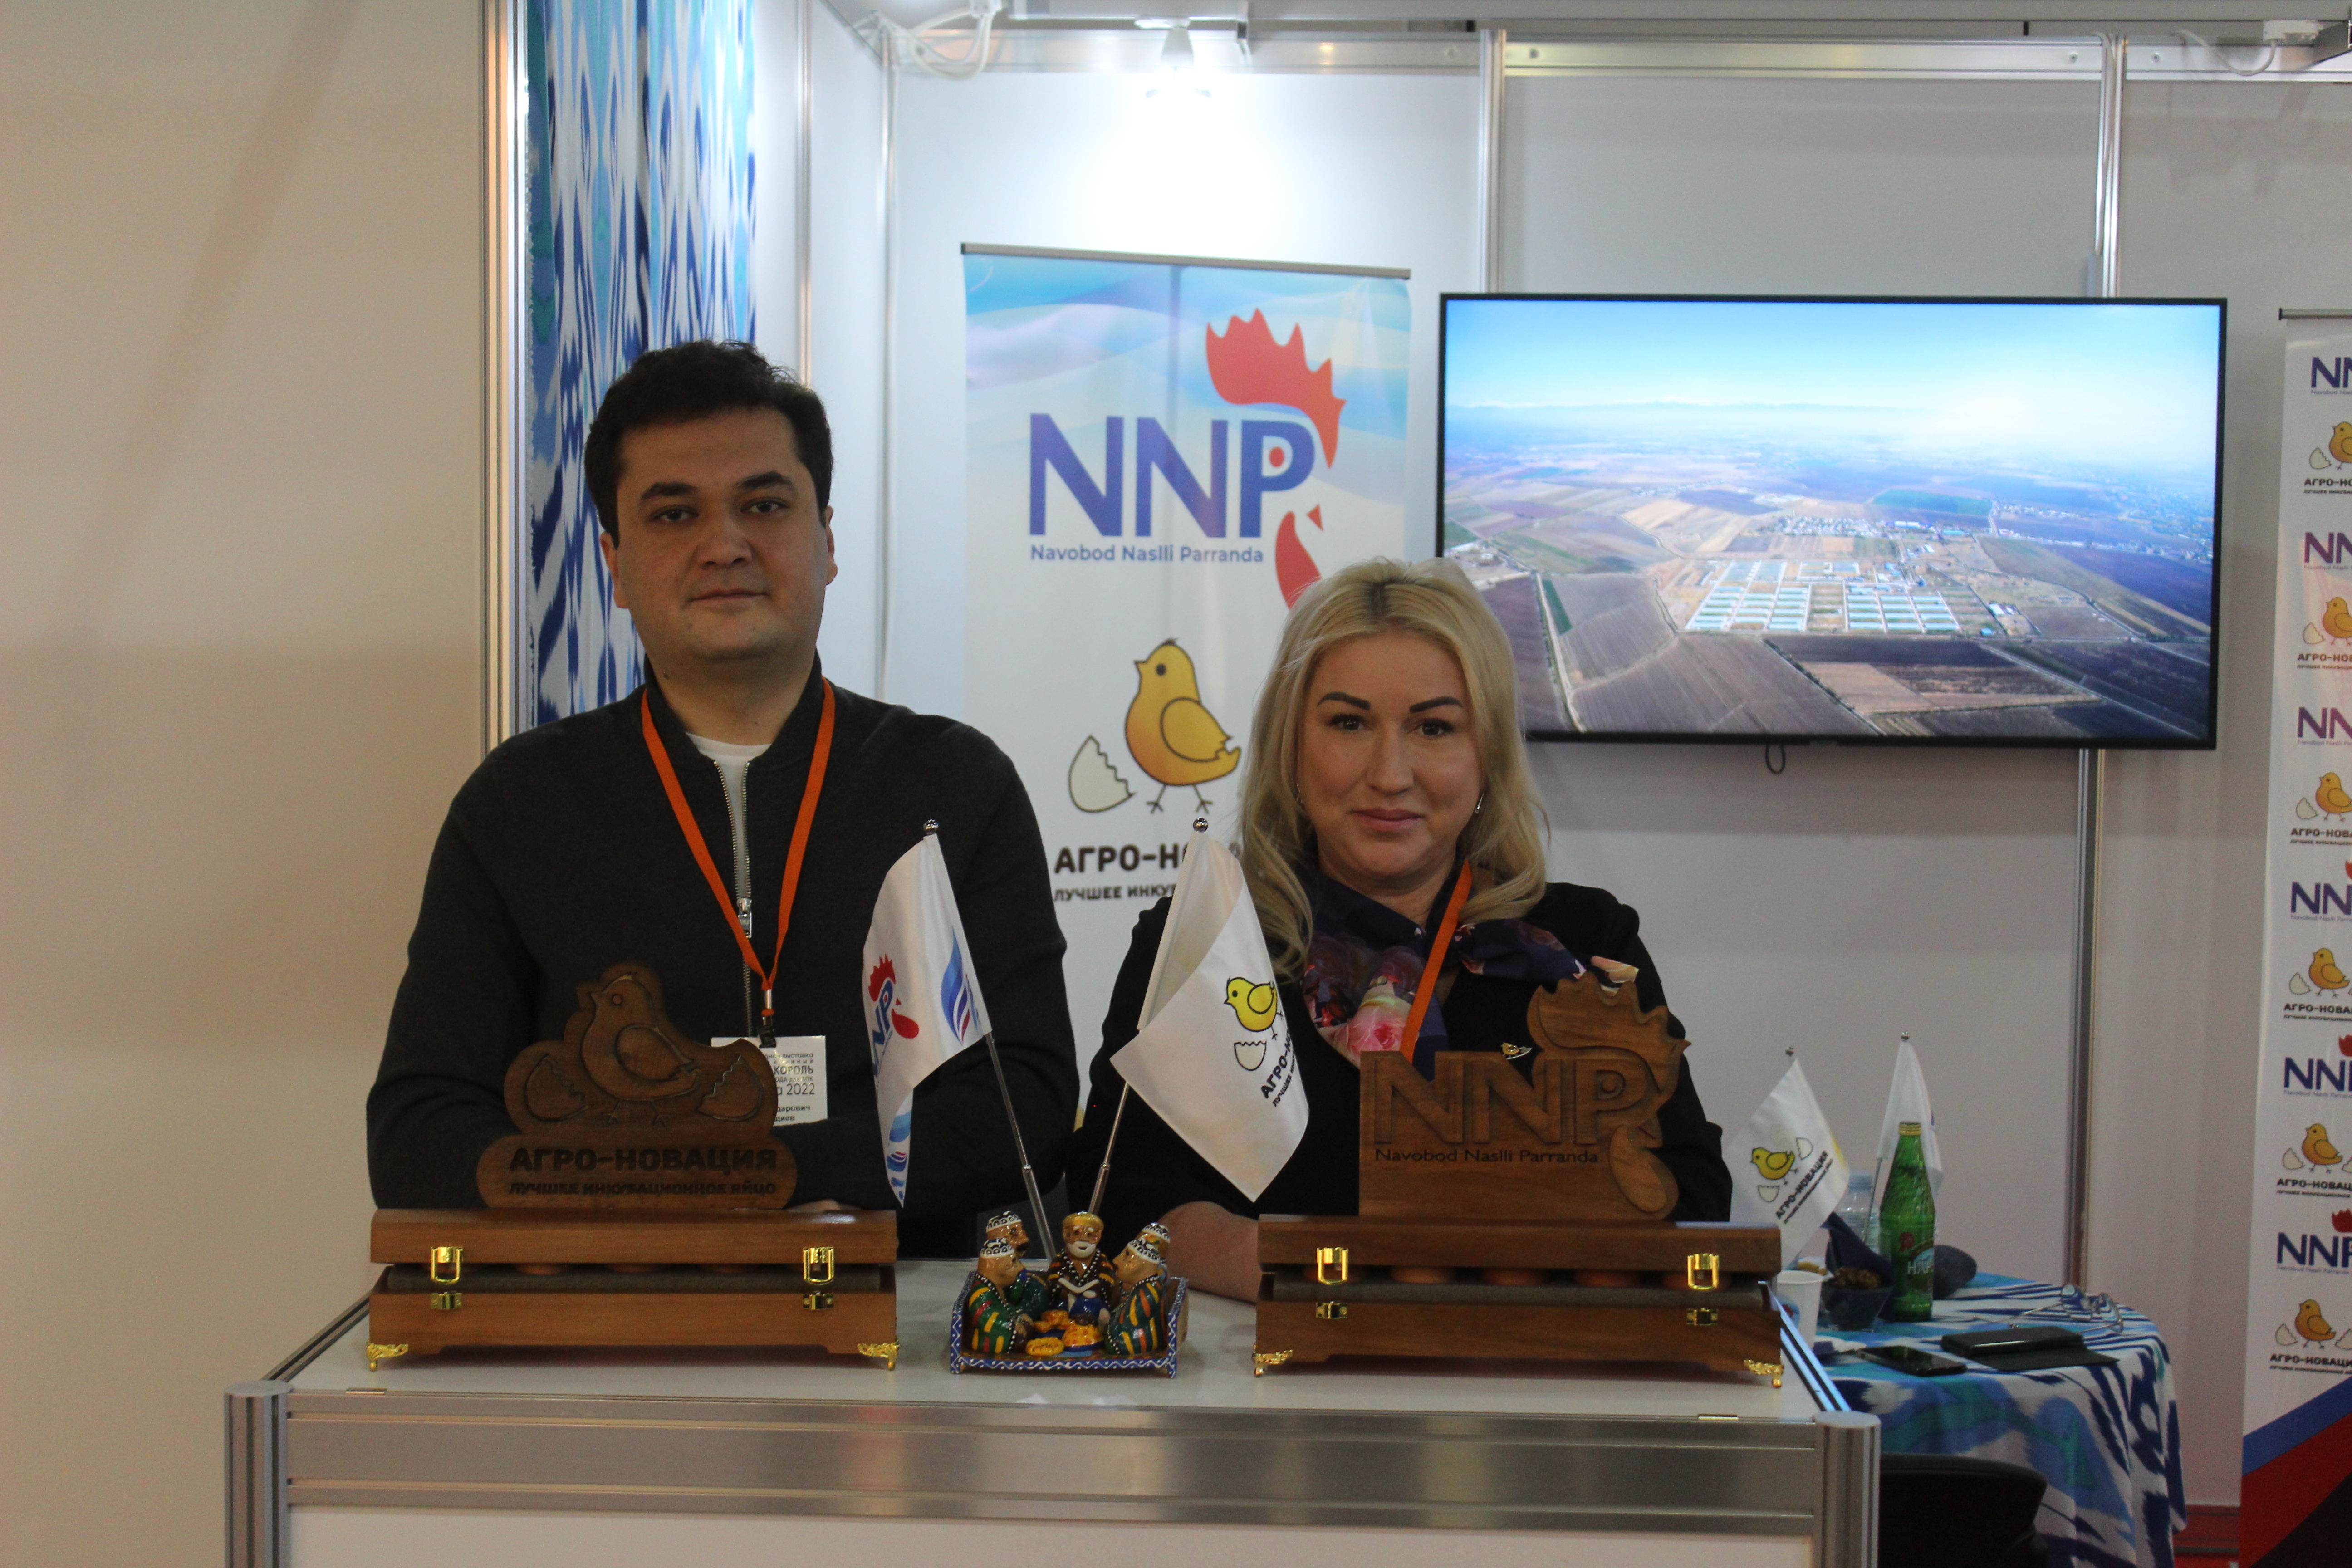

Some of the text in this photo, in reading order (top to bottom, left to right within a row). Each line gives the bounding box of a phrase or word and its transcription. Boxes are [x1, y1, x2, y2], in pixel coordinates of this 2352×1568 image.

[1029, 413, 1315, 539] NNP
[1031, 544, 1115, 561] Navobod
[1181, 546, 1264, 563] Parranda
[1054, 843, 1189, 873] АГРО-Н
[1054, 886, 1122, 902] ЛУЧШЕЕ
[2283, 1003, 2352, 1014] АГРО-НОВА
[774, 1065, 813, 1075] КОРОЛЬ
[2284, 1057, 2352, 1092] NN
[786, 1083, 815, 1095] 2022
[1374, 1059, 1647, 1145] NNP
[509, 1148, 777, 1176] АГРО-НОВАЦИЯ
[1375, 1149, 1457, 1162] Navobod
[1519, 1150, 1598, 1163] Parranda
[509, 1182, 579, 1195] ЛУЧШЕЕ
[731, 1180, 776, 1196] ЯЙЦО
